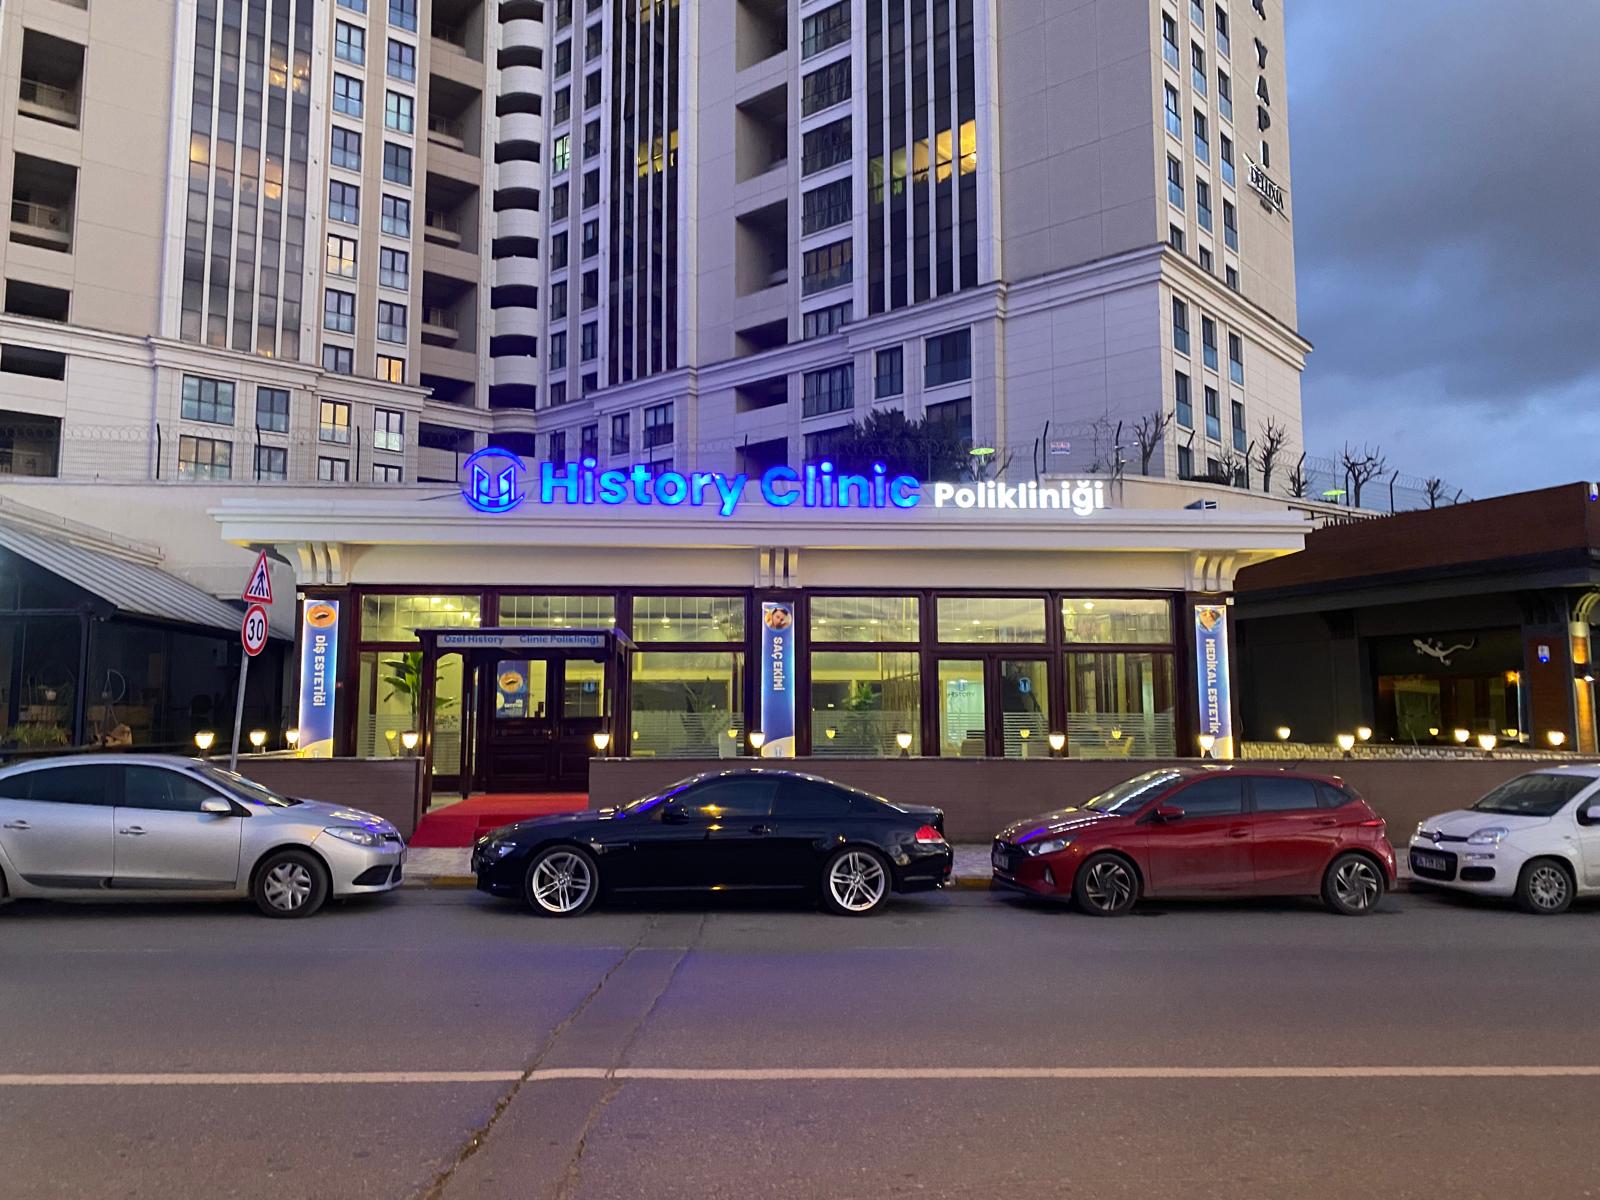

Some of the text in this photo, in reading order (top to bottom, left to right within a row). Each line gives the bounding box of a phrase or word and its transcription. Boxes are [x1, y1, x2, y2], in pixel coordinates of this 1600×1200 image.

[1254, 37, 1271, 168] YAPI
[539, 456, 1105, 516] History Clinic Polikliniği
[247, 618, 264, 641] 30
[771, 636, 783, 660] SAÇ
